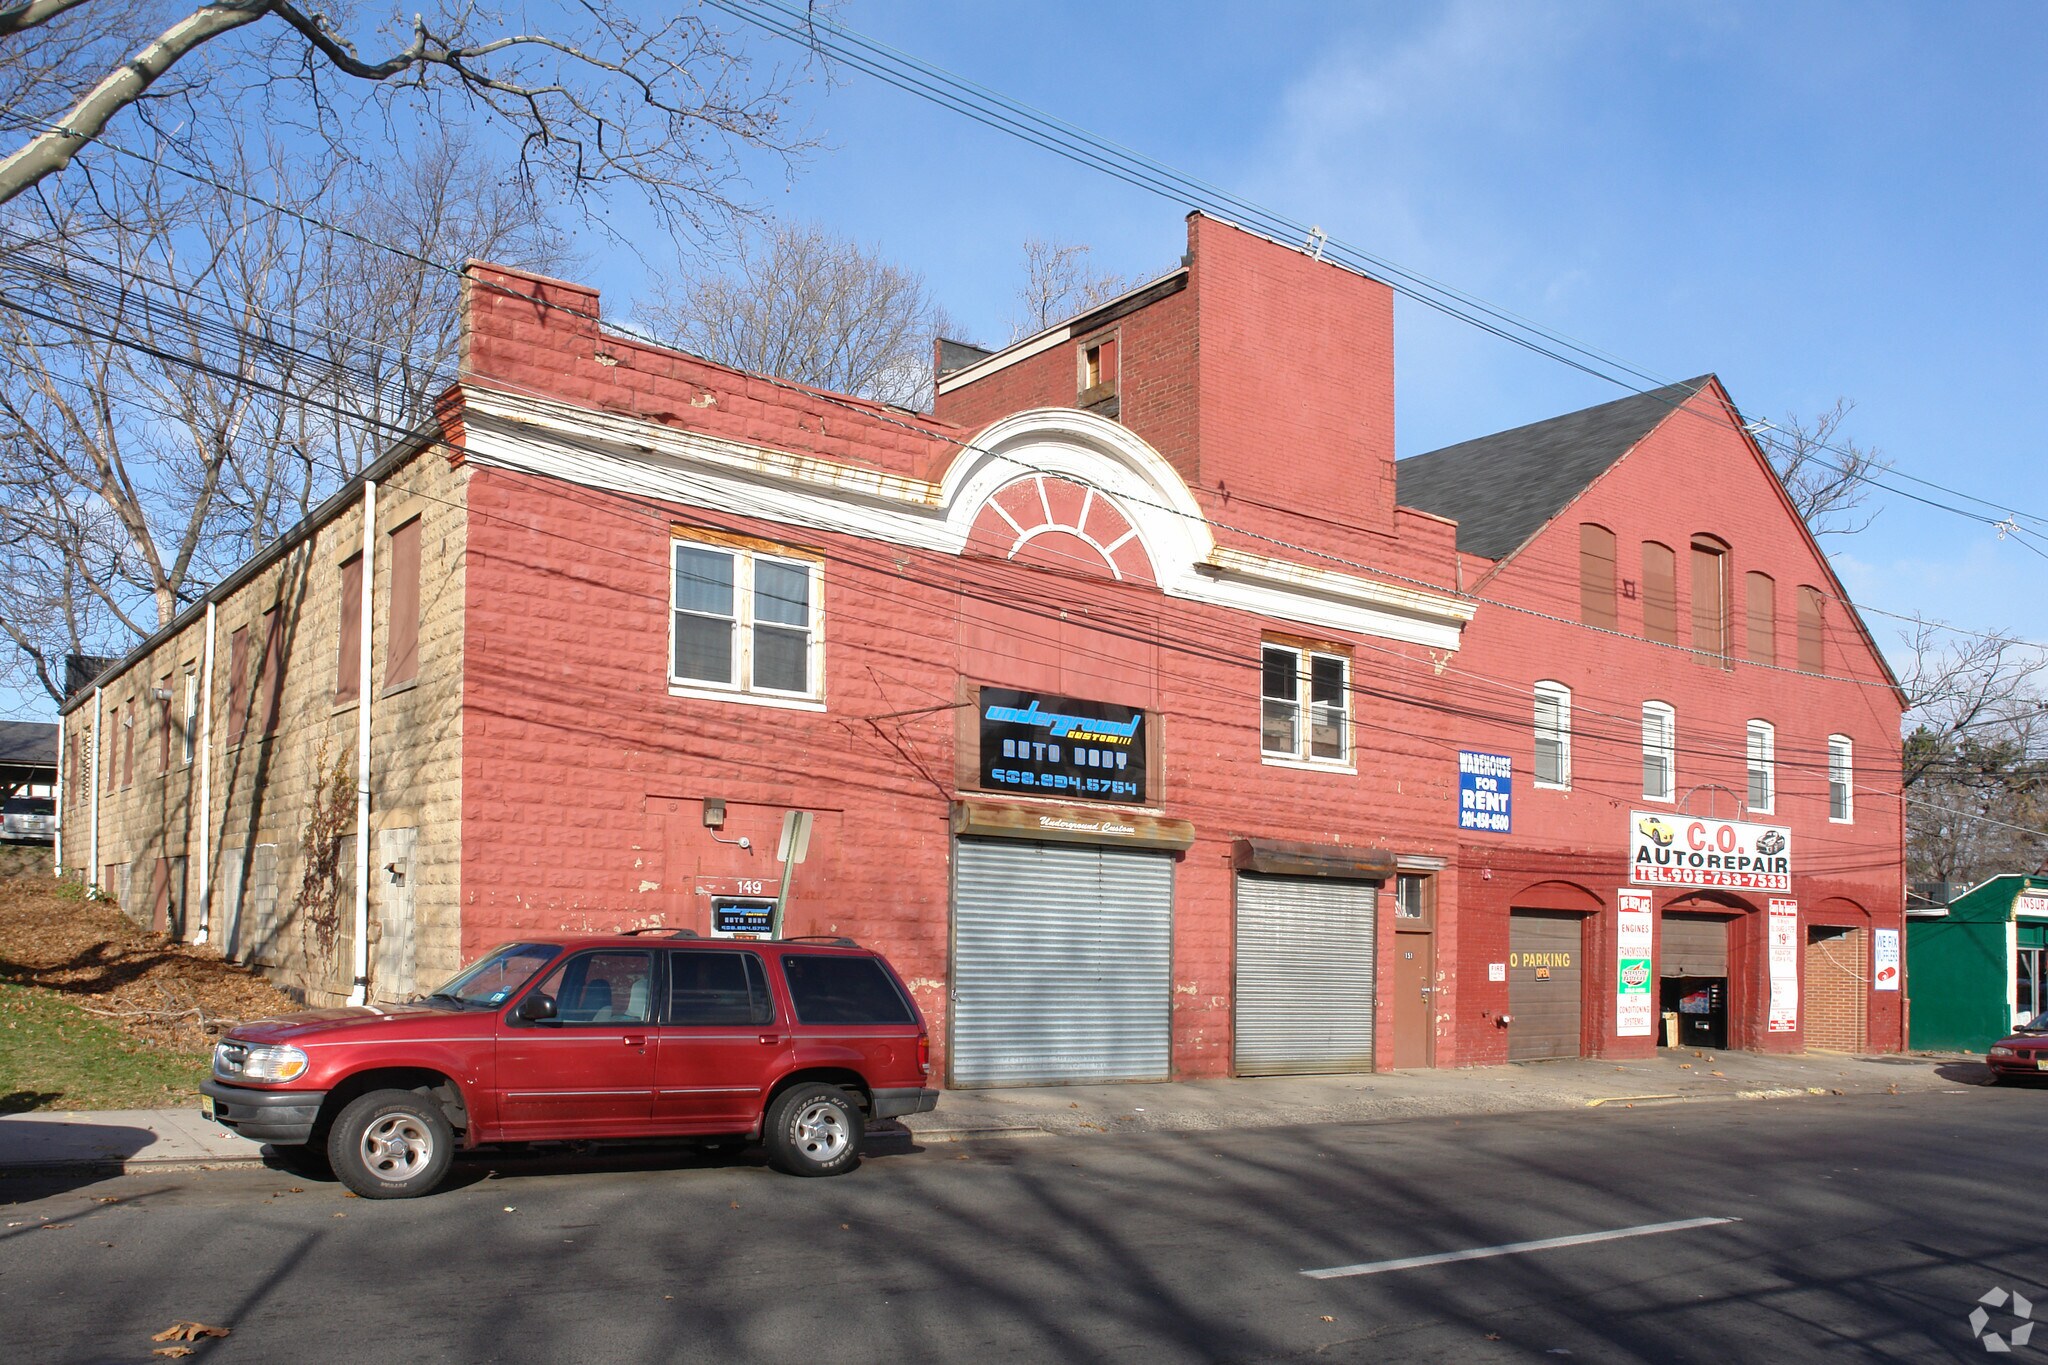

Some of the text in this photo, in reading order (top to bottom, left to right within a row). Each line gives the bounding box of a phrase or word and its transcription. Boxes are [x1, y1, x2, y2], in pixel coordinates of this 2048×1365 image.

[985, 700, 1141, 737] underground
[1003, 739, 1127, 770] AUTO BODY
[1459, 752, 1511, 778] WAREHOUSE
[1475, 777, 1498, 791] FOR
[1462, 789, 1509, 812] RENT
[1040, 816, 1135, 833] Underground Custom
[1687, 822, 1744, 854] C.O.
[1636, 845, 1787, 873] AUTOREPAIR
[737, 880, 762, 894] 149
[2020, 898, 2048, 911] INSUR
[1621, 924, 1649, 933] ENGINES
[1877, 935, 1897, 948] WE FIX
[1510, 953, 1571, 967] O PARKING
